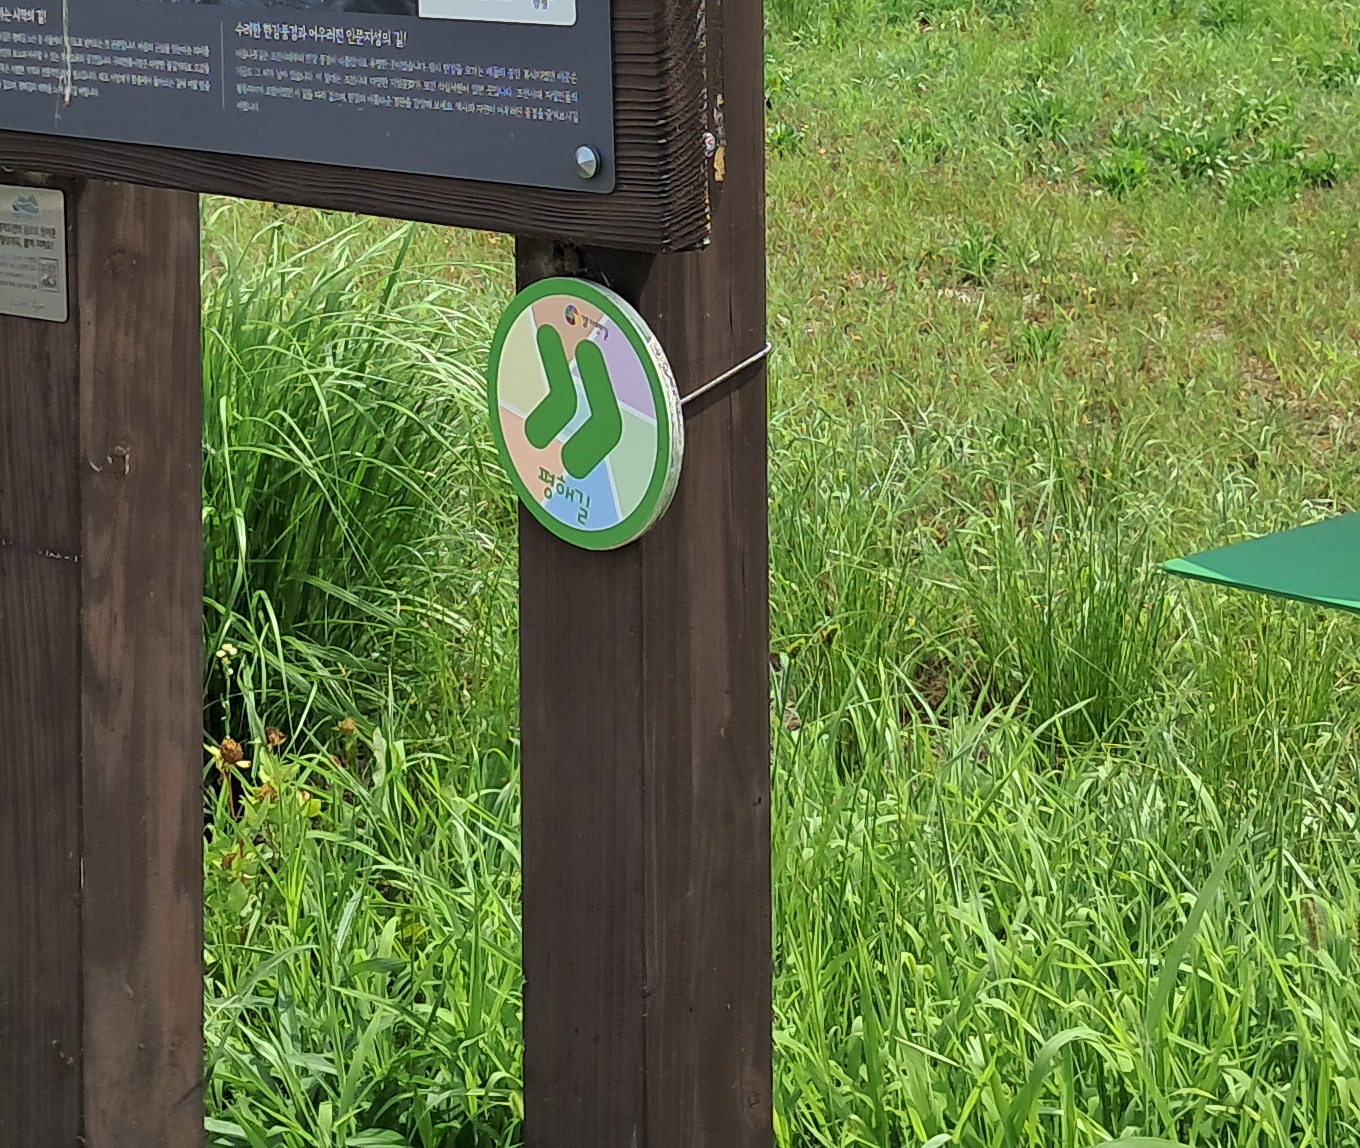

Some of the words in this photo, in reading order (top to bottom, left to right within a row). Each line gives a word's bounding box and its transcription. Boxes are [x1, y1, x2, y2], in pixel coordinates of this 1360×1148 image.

[234, 21, 262, 39] 수려한
[263, 23, 307, 42] 한강풍경과
[308, 26, 345, 44] 어우러진
[395, 30, 409, 48] 길!
[538, 466, 591, 526] 평해길
